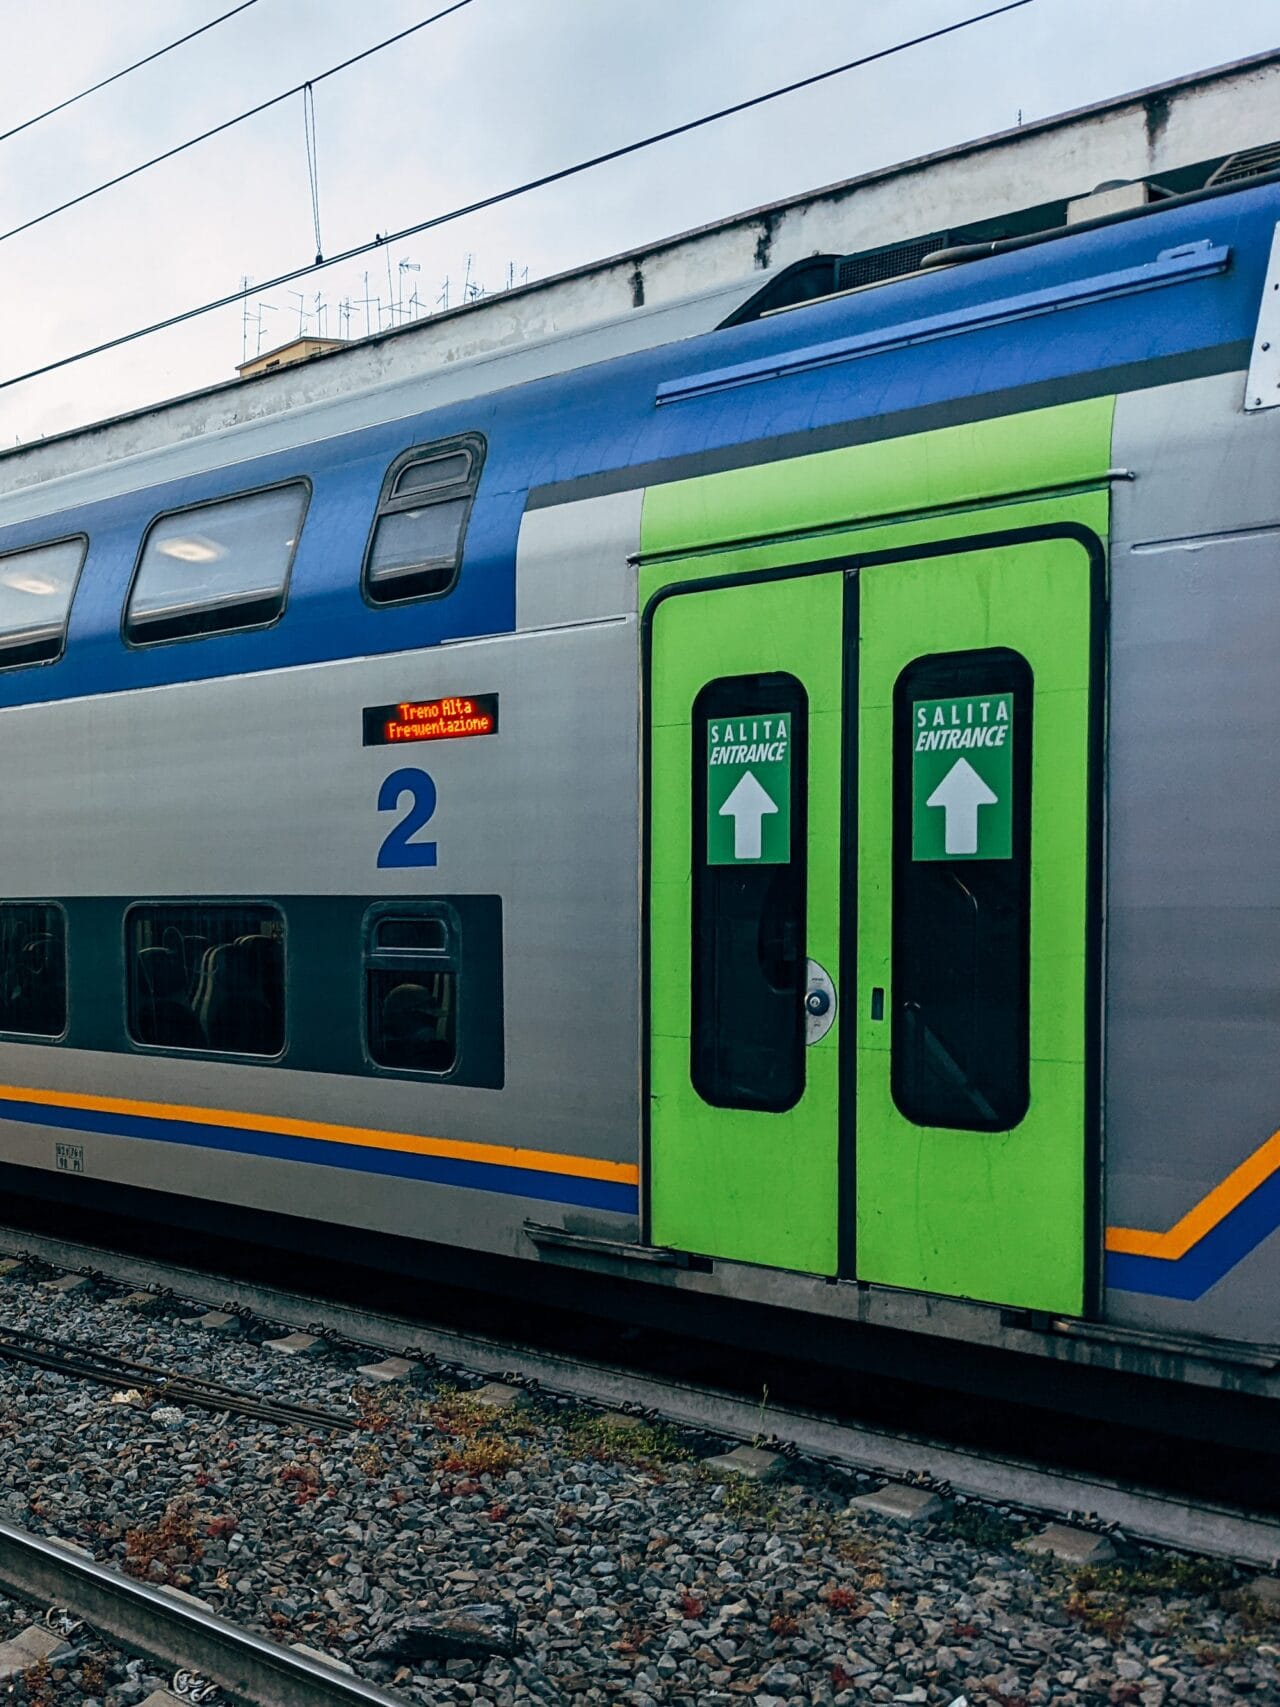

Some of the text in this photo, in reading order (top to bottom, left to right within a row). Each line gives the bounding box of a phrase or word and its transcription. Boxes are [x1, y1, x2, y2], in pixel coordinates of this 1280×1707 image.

[399, 698, 473, 721] Treno Alta
[917, 701, 1009, 727] SALITA
[388, 716, 489, 739] Frequentazione
[711, 719, 788, 743] SALITA
[915, 724, 1009, 752] ENTRANCE
[709, 741, 788, 766] ENTRANCE
[377, 767, 437, 868] 2
